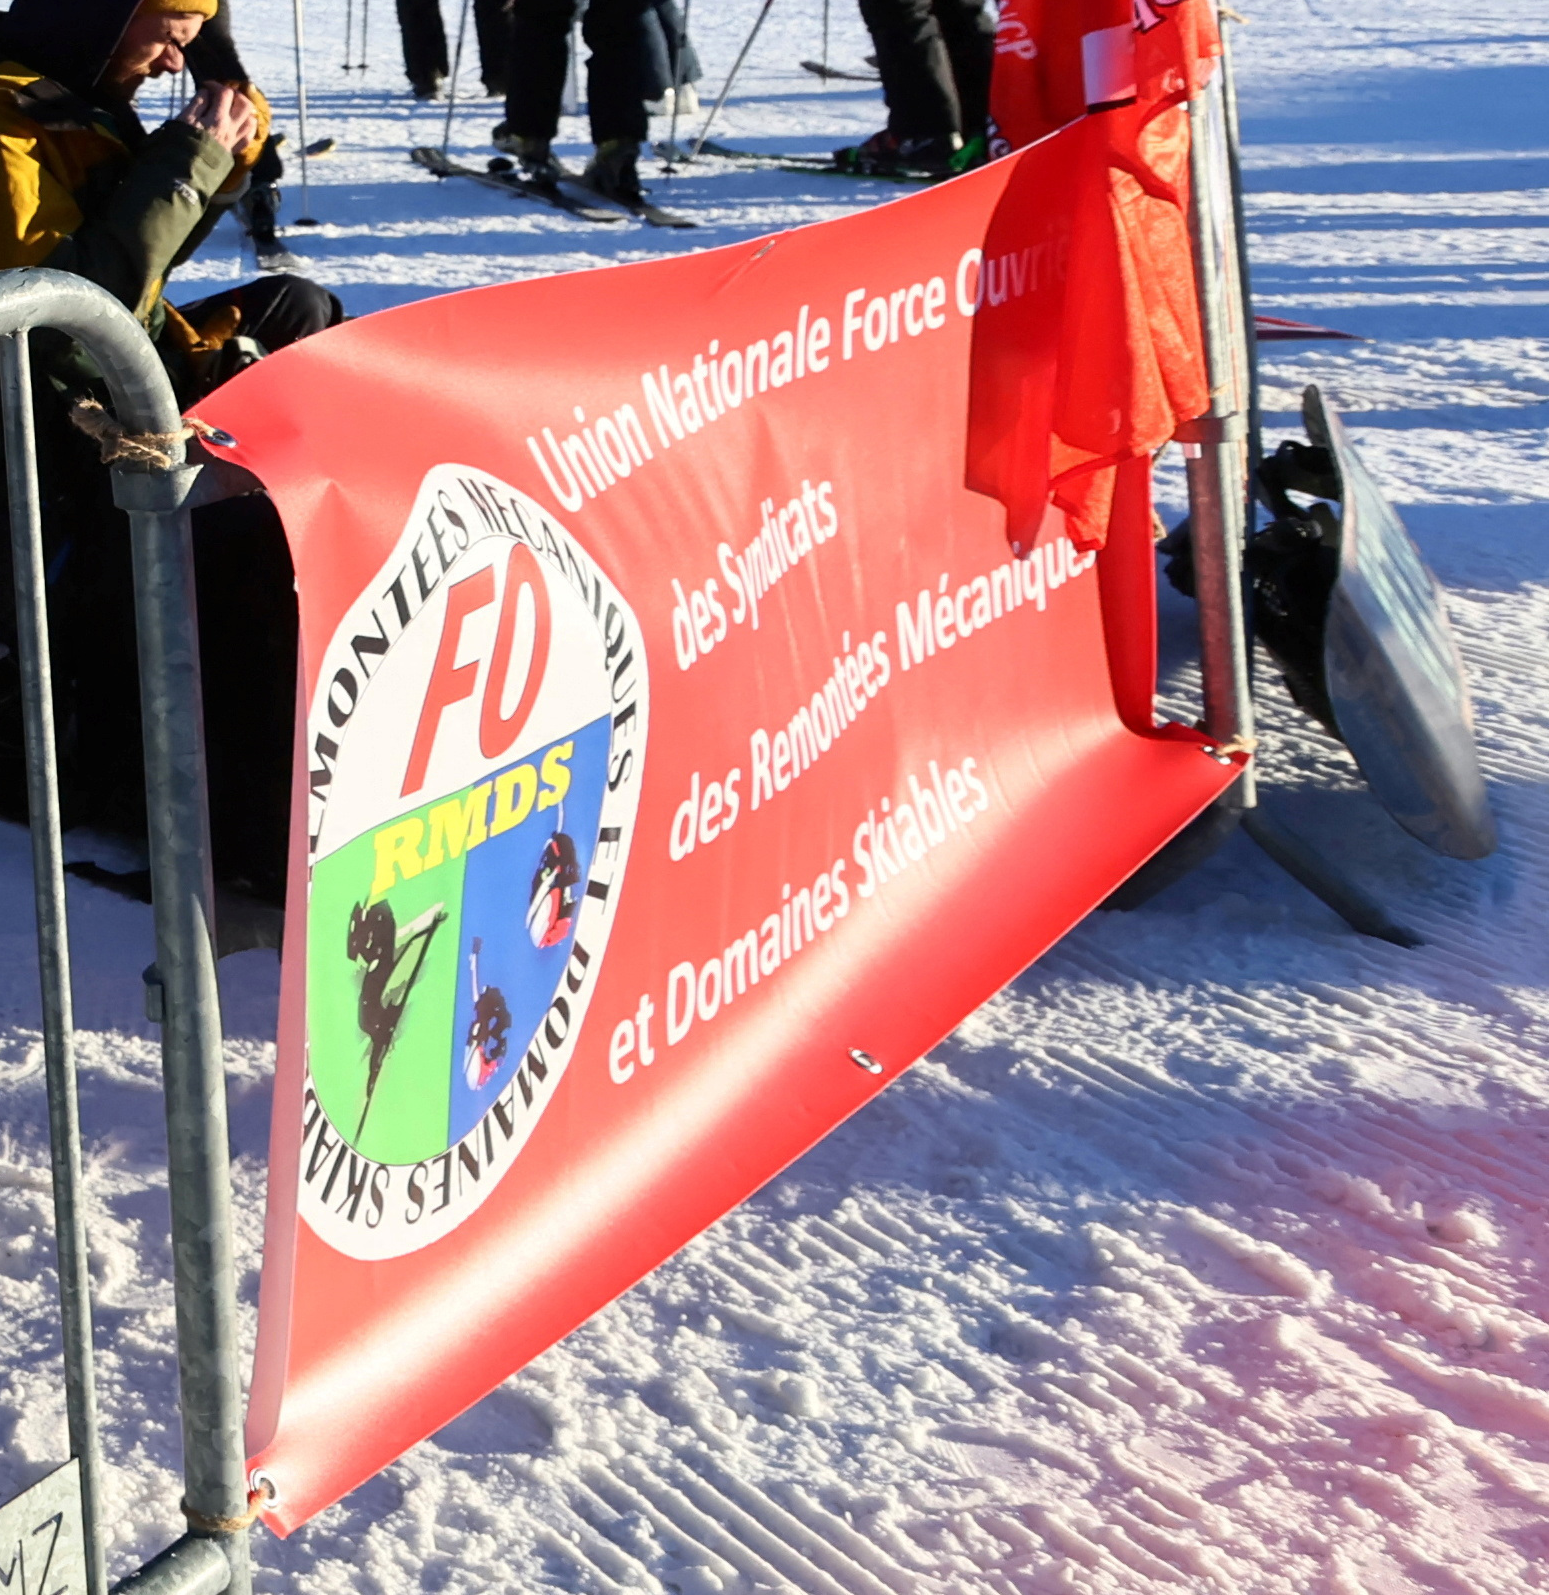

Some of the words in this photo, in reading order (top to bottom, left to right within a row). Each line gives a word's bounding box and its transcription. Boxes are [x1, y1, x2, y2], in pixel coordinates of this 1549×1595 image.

[527, 406, 653, 511] Union
[641, 305, 830, 448] Nationale
[842, 276, 945, 360] Force
[400, 542, 553, 799] FO
[469, 474, 642, 793] MECANIQUES
[672, 578, 727, 670] des
[717, 479, 837, 630] Syndicats
[369, 740, 576, 906] RMDS
[669, 768, 741, 861] des
[750, 630, 890, 810] Remontées
[585, 826, 622, 915] ET
[609, 994, 655, 1084] et
[666, 858, 850, 1046] Domaines
[853, 757, 989, 898] Skiables
[404, 943, 590, 1225] DOMAINES
